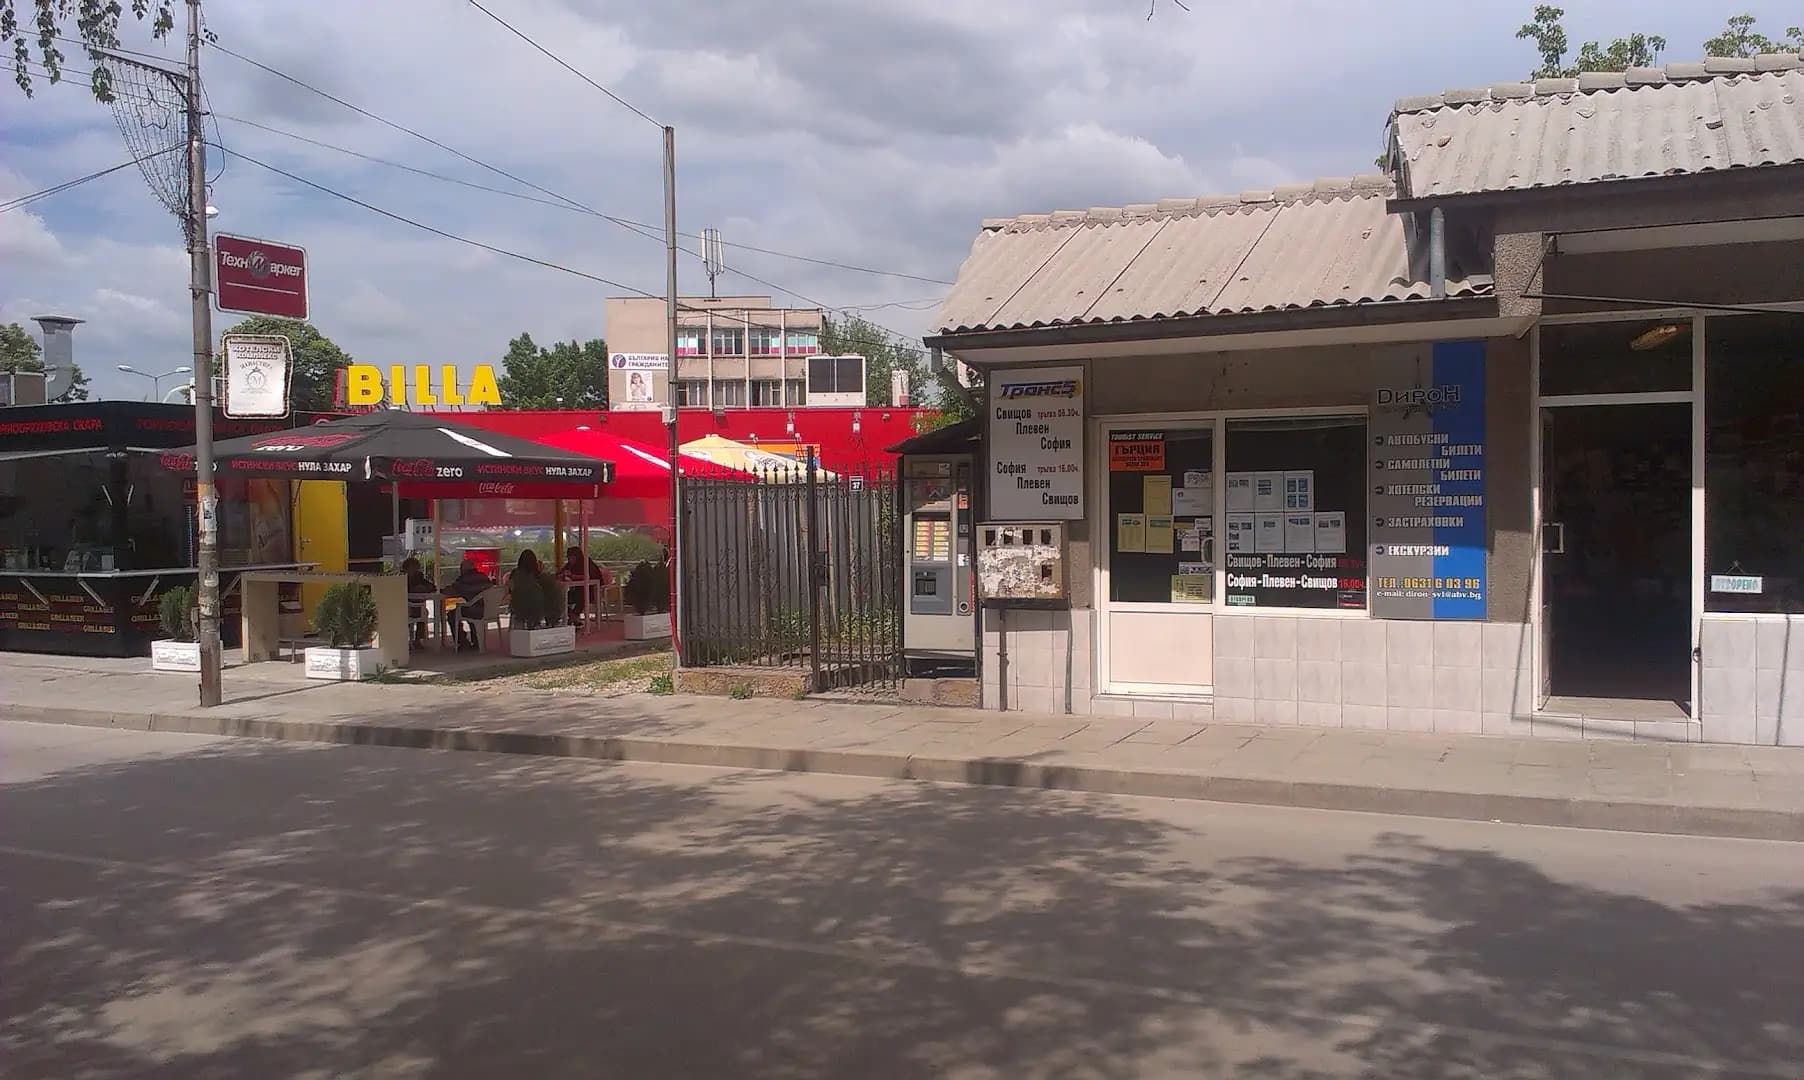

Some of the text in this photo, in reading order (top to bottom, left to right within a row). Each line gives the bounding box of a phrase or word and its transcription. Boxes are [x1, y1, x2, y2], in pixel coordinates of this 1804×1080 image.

[348, 364, 502, 406] BILLA
[996, 407, 1032, 421] Свищов
[1016, 422, 1050, 435] Плевен
[1040, 437, 1071, 452] София
[1387, 433, 1449, 445] АВТОБУСНИ
[1441, 445, 1482, 456] БИЛЕТИ
[299, 461, 321, 472] НУЛА
[323, 462, 352, 473] ЗАХАР
[997, 462, 1027, 477] София
[1387, 458, 1450, 470] САМОЛЕТНИ
[436, 466, 463, 478] zero
[545, 466, 567, 476] НУЛА
[568, 468, 593, 478] ЗАХАР
[1440, 470, 1481, 481] БИЛЕТИ
[1017, 477, 1051, 489] Плевен
[1388, 484, 1441, 495] ХОТЕЛСКИ
[1042, 492, 1079, 507] Свищов
[1415, 495, 1482, 507] РЕЗЕРВАЦИИ
[1388, 516, 1464, 528] ЗАСТРАХОВКИ
[1388, 545, 1450, 556] ЕКСКУРЗИИ
[1464, 578, 1480, 589] 96
[1376, 590, 1405, 598] e-mail:
